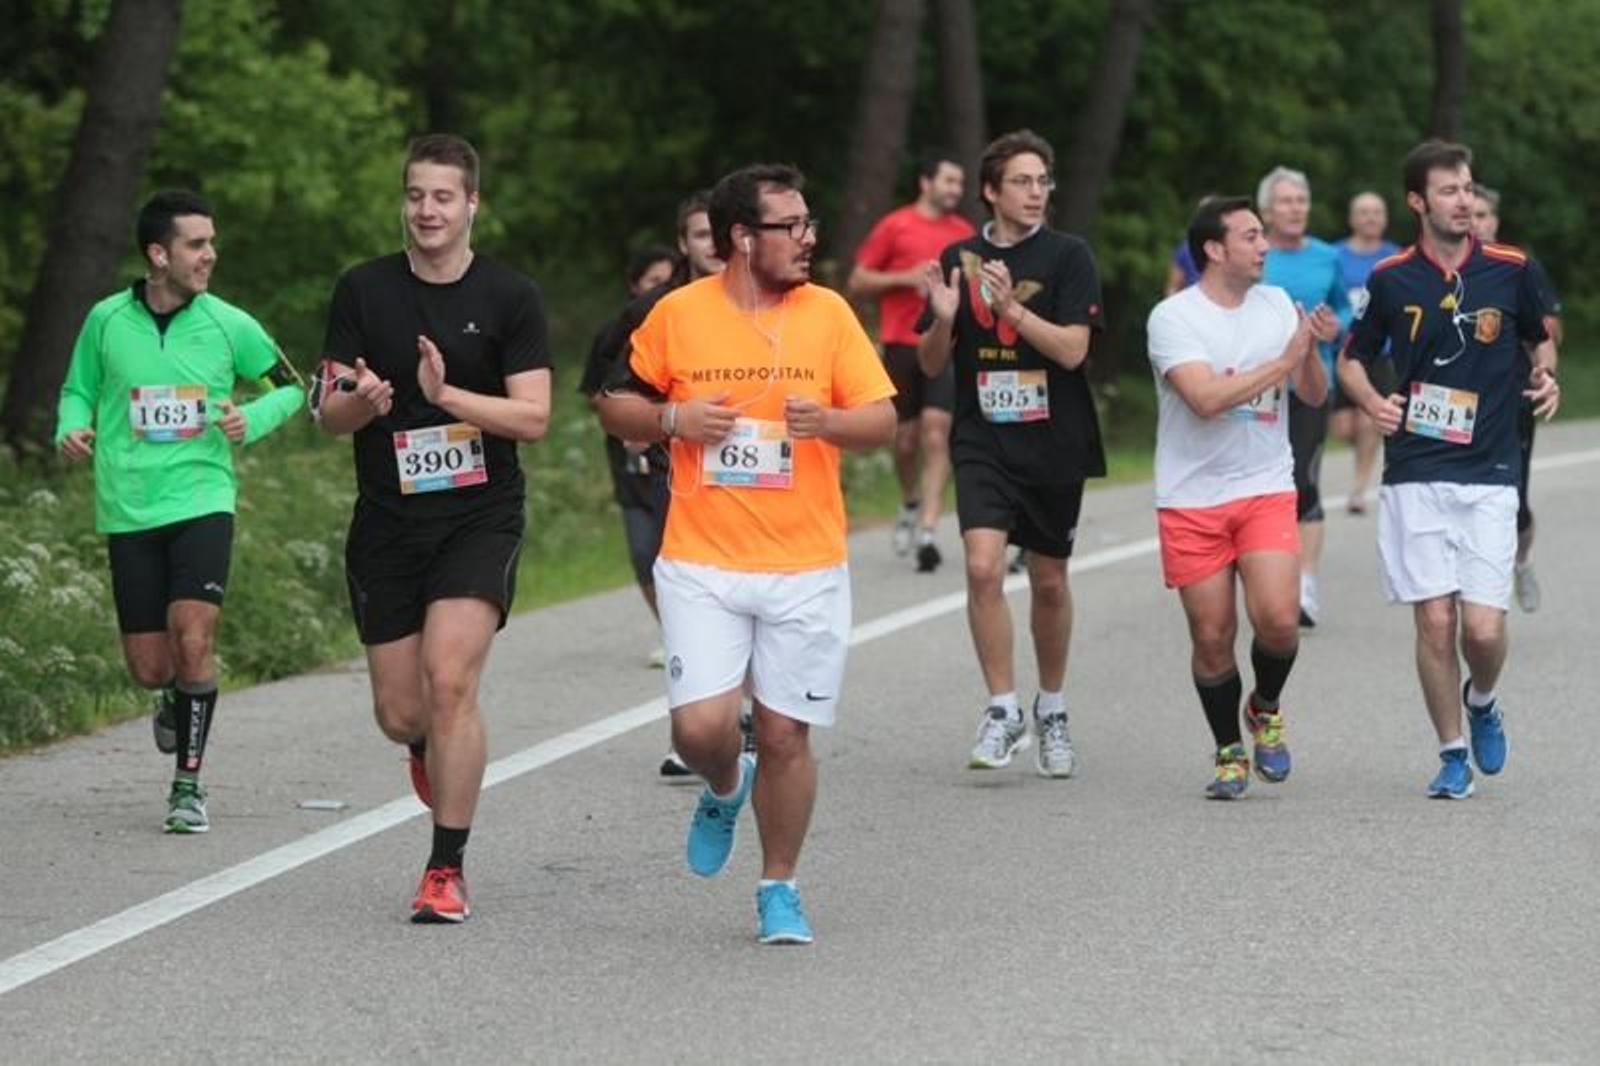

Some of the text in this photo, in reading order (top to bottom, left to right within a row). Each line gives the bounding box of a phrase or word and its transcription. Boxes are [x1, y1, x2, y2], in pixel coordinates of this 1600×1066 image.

[1403, 305, 1422, 342] 7
[692, 367, 815, 383] METROPOLITAN
[984, 389, 1028, 408] 395
[141, 405, 187, 426] 163
[1413, 400, 1456, 425] 284
[405, 447, 463, 475] 390
[720, 444, 758, 468] 68
